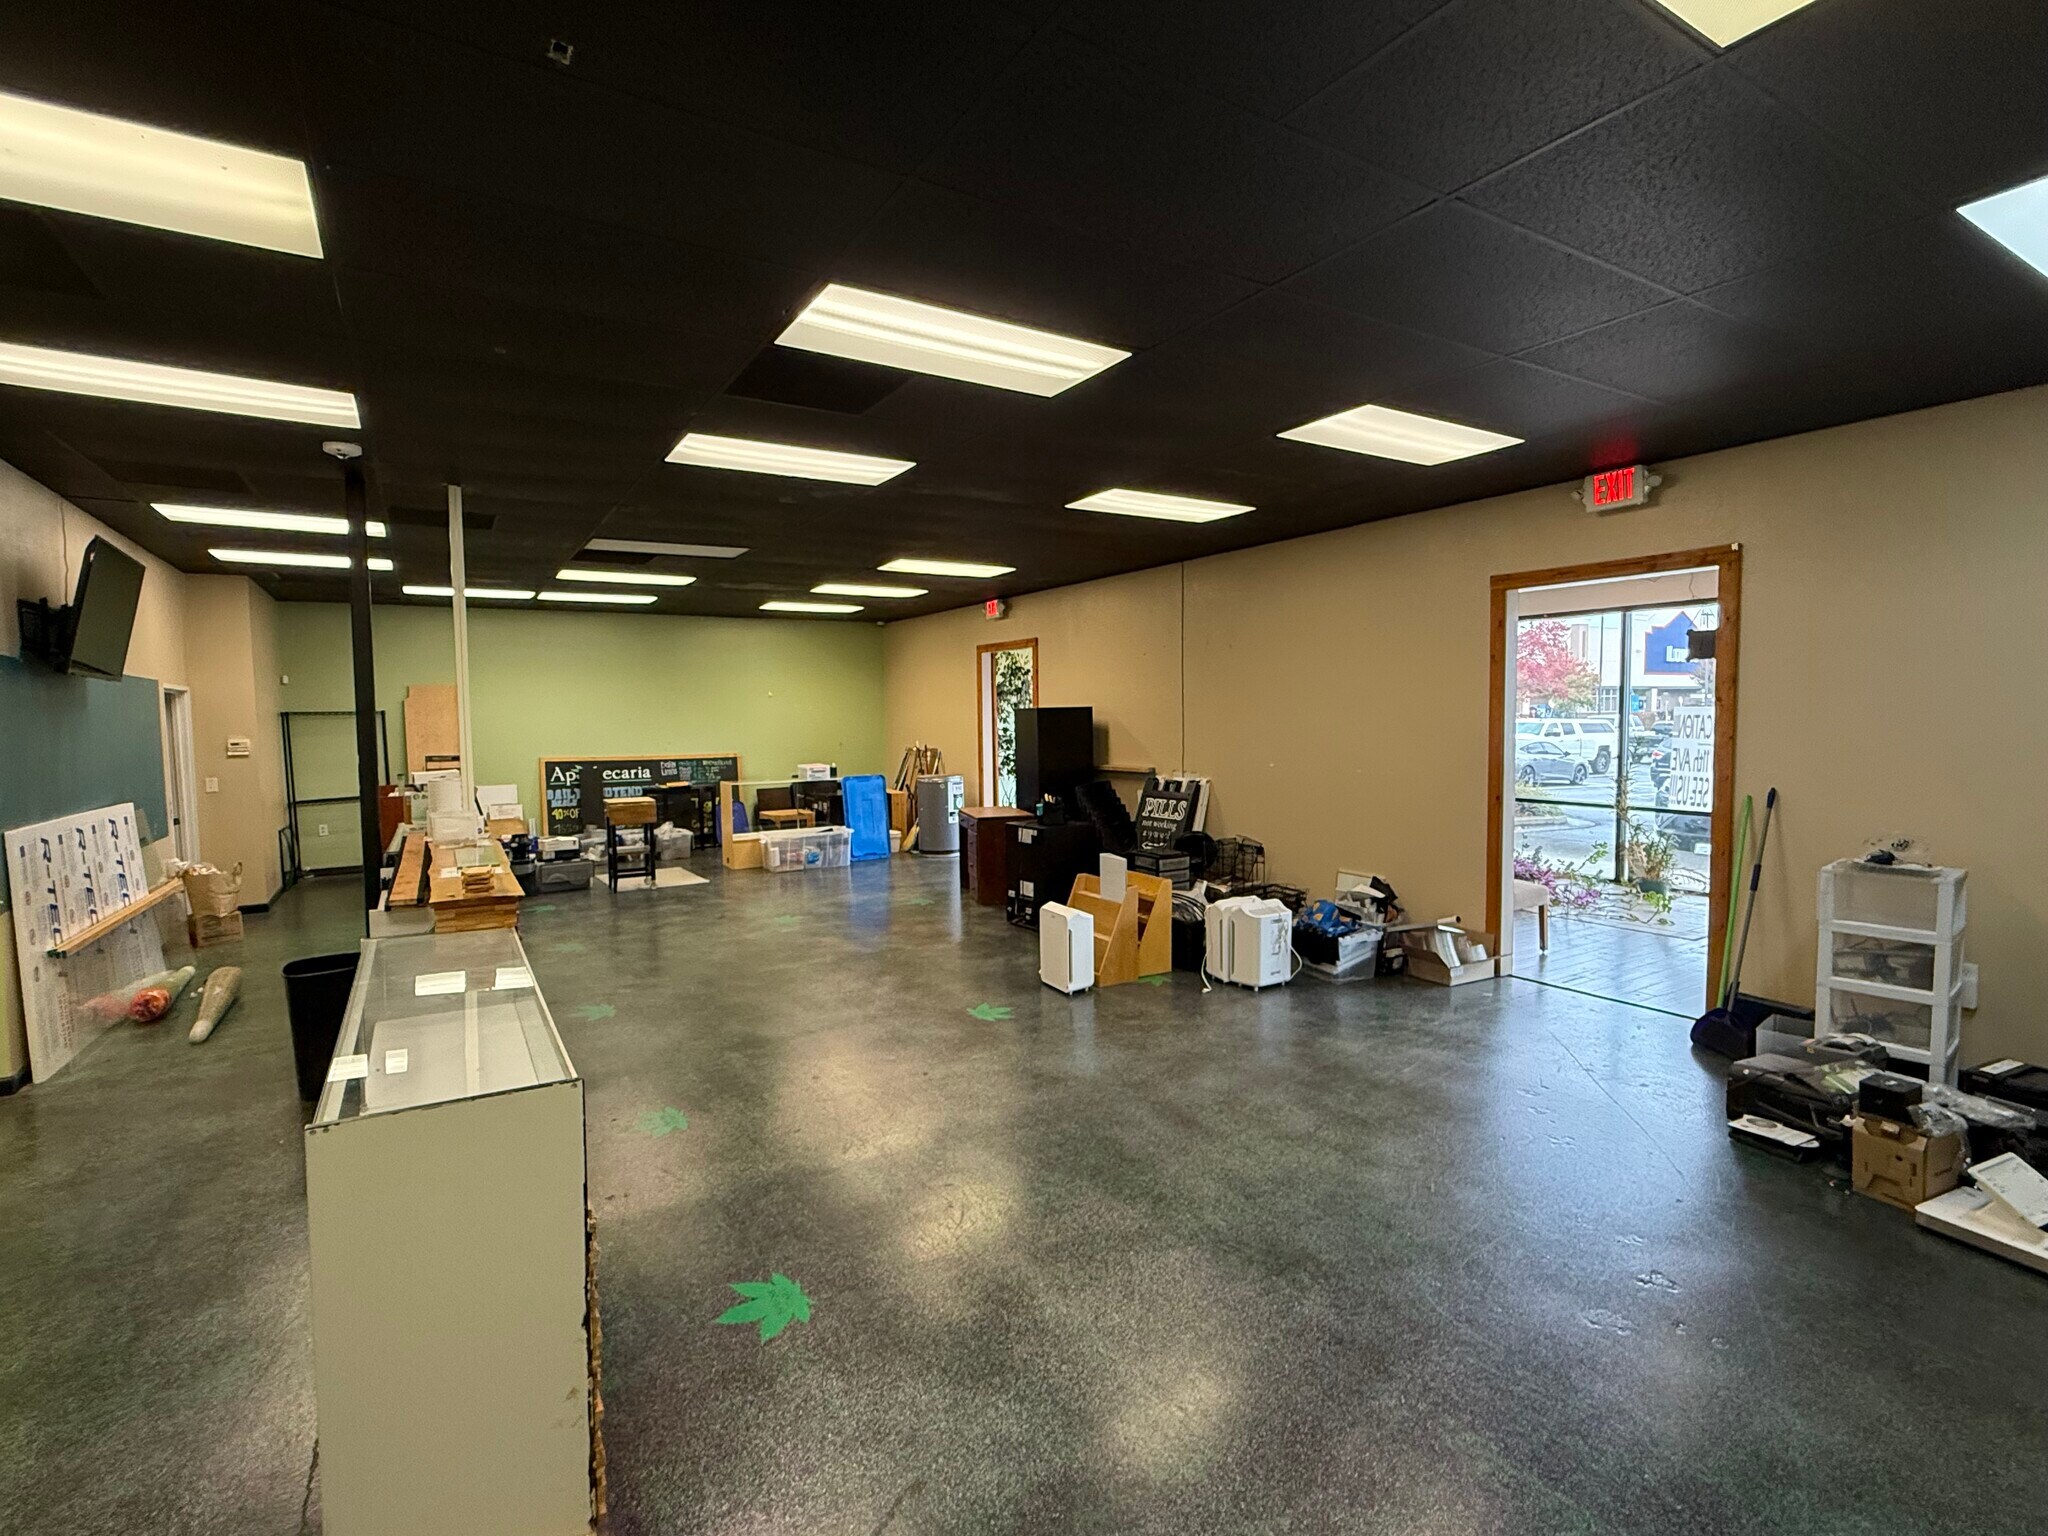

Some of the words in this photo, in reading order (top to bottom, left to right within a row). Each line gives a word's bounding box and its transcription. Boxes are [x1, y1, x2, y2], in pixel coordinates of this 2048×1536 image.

[1593, 467, 1635, 505] EXIT
[1142, 797, 1188, 820] PILLS
[40, 837, 64, 947] R-TEC
[76, 827, 100, 926] R-TEC
[108, 818, 132, 908] R-TEC
